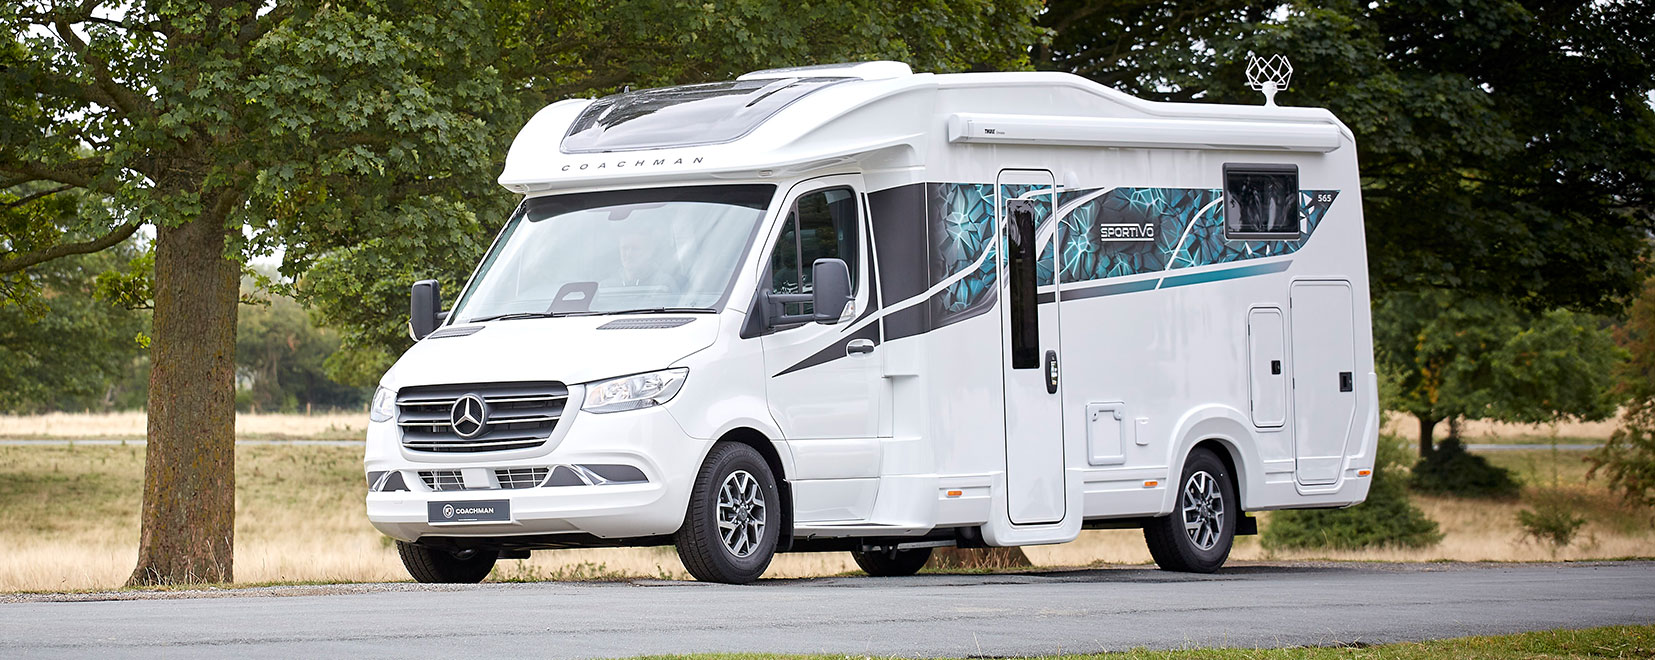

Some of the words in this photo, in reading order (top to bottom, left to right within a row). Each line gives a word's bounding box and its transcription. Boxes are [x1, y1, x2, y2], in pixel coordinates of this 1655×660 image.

[561, 157, 704, 172] COACHMAN
[1317, 194, 1332, 202] 565
[455, 507, 495, 515] COACHMAN
